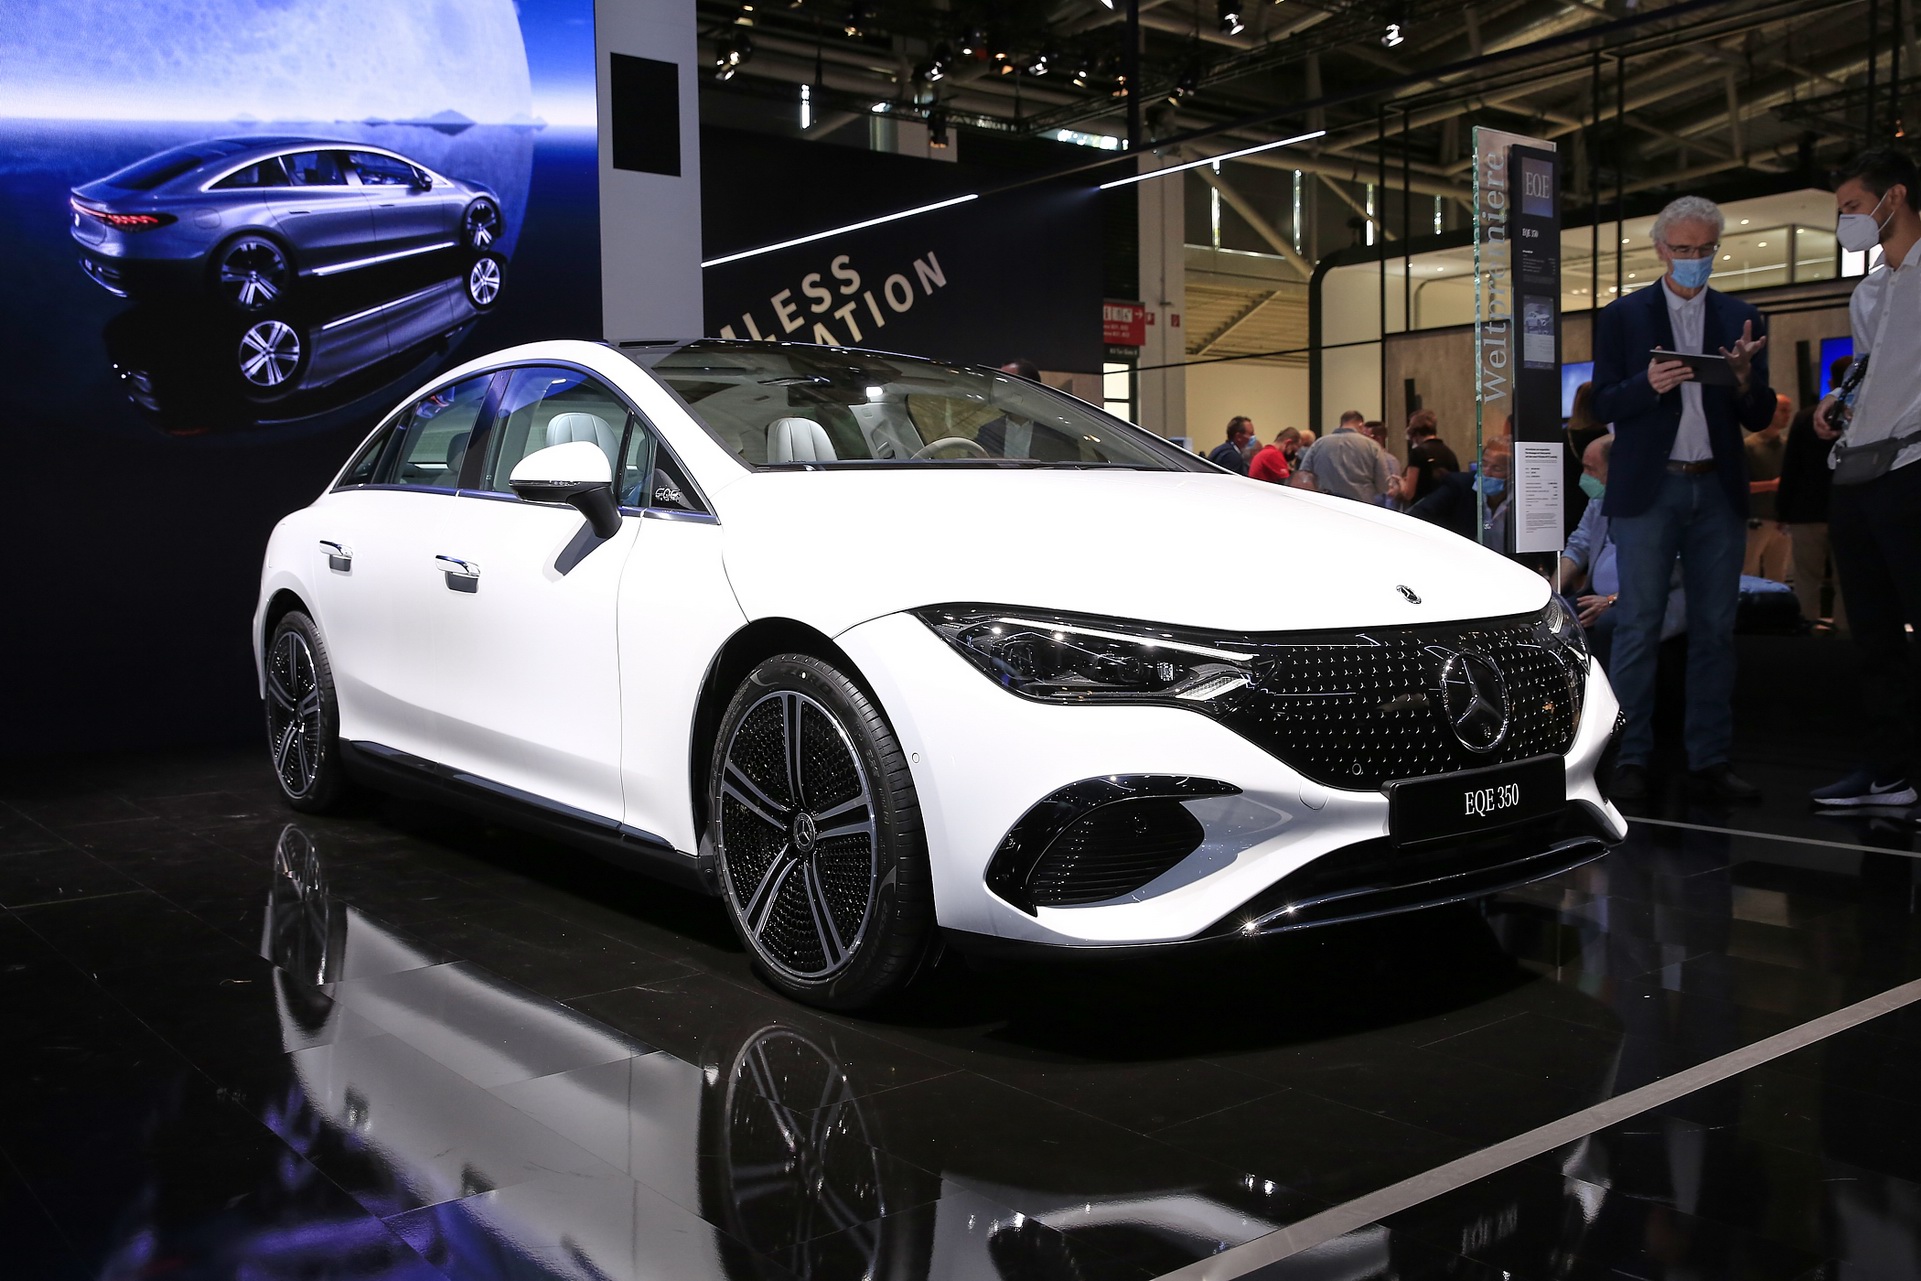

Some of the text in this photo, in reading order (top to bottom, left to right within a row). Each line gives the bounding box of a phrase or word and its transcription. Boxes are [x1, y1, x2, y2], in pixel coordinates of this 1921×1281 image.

[1525, 171, 1550, 199] EQE
[1482, 152, 1511, 405] Weltpremiere
[1464, 783, 1520, 817] EQE 350
